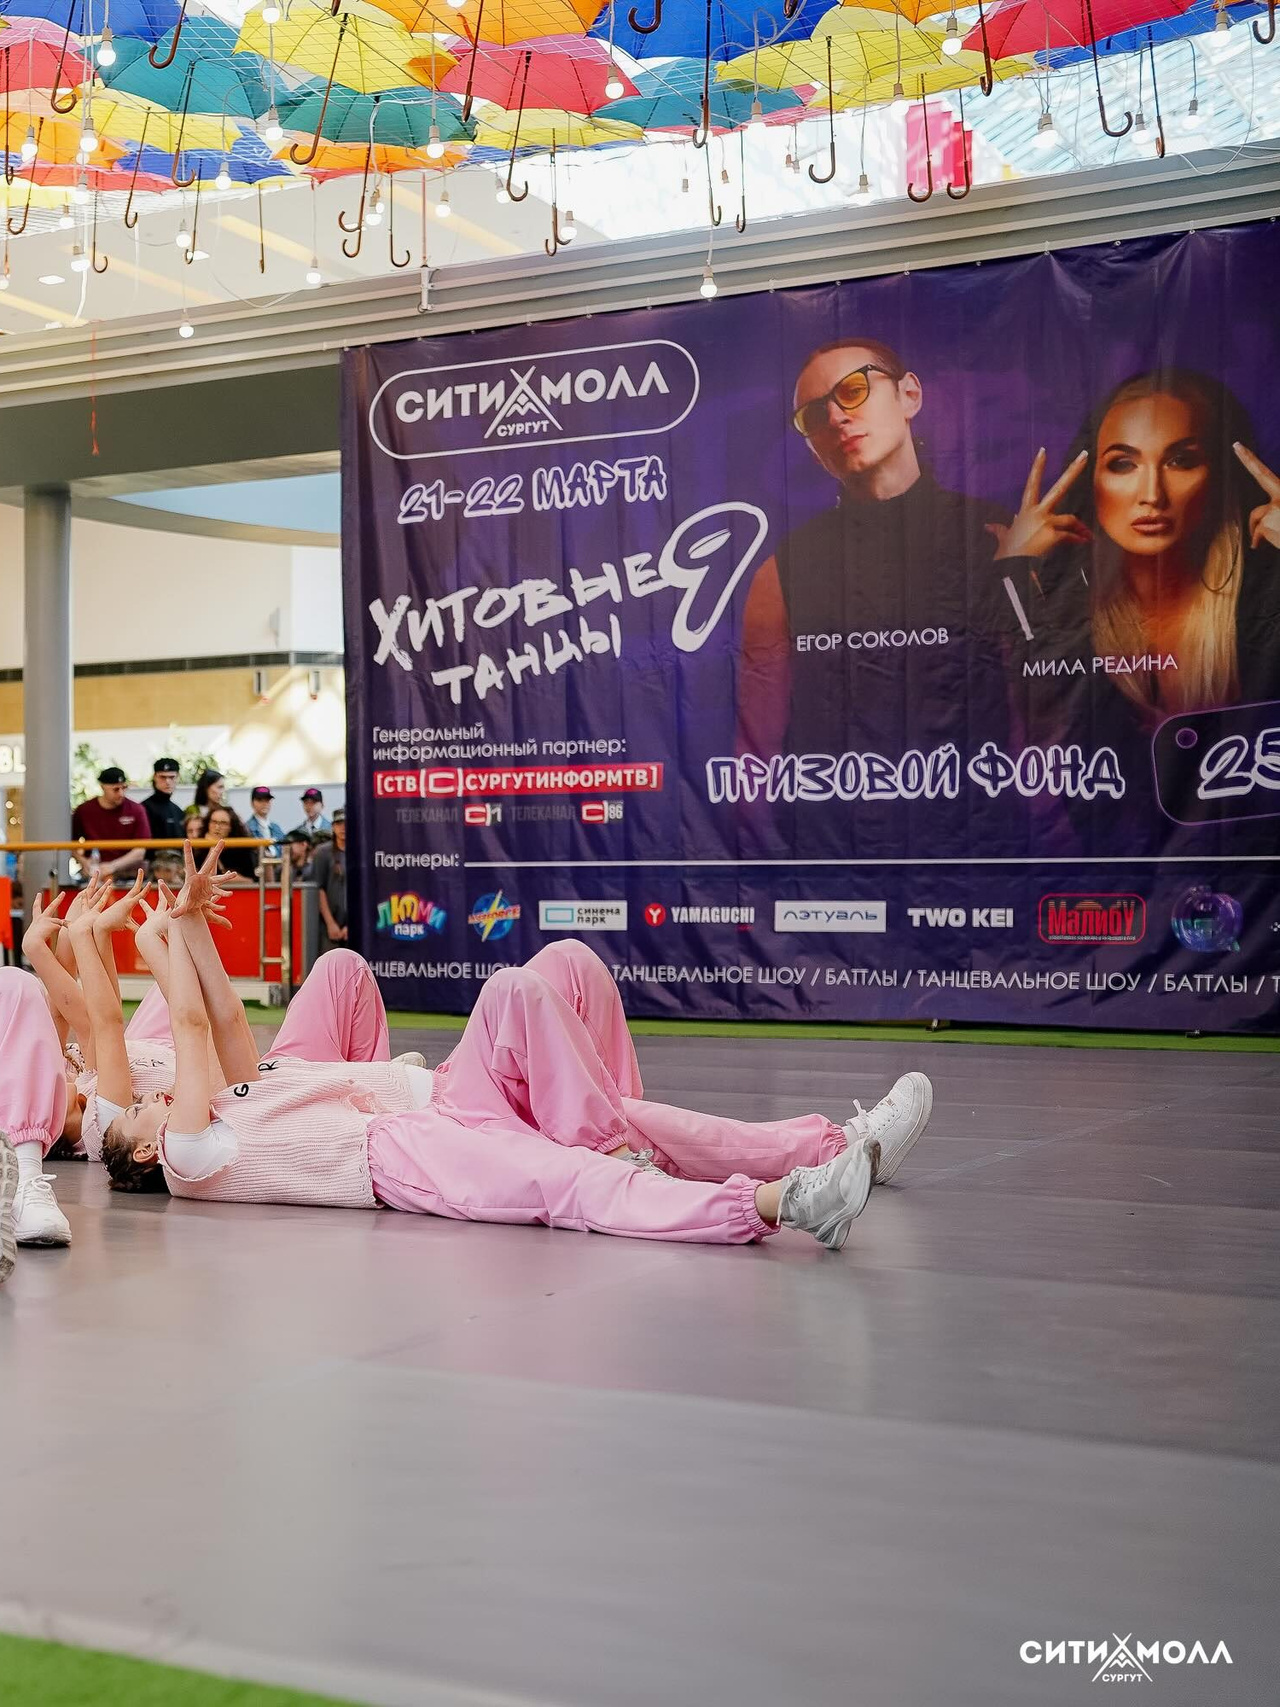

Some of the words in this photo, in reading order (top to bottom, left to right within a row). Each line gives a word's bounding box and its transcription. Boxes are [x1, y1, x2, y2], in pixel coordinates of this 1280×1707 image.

[395, 380, 506, 422] СИТИ
[541, 362, 670, 406] МОЛЛ
[497, 420, 549, 437] СУРГУТ
[397, 475, 524, 524] 21-22
[532, 455, 668, 511] МАРТА
[796, 633, 842, 652] ЕГОР
[847, 627, 949, 650] СОКОЛОВ
[1023, 657, 1086, 678] МИЛА
[1092, 653, 1178, 676] РЕДИНА
[373, 722, 485, 743] Генеральный
[373, 739, 537, 763] информационный
[543, 738, 627, 759] партнер:
[706, 743, 961, 803] ПРИЗОВОЙ
[967, 742, 1126, 800] ФОНД
[375, 850, 460, 871] Партнеры:
[671, 906, 755, 924] YAMAGUCHI
[907, 907, 966, 927] TWO
[972, 907, 1014, 928] KEI
[371, 961, 471, 979] НЦЕВАЛЬНОЕ
[612, 964, 753, 984] ТАНЦЕВАЛЬНОЕ
[758, 966, 807, 984] ШОУ
[825, 968, 897, 987] БАТТЛЫ
[917, 969, 1080, 990] ТАНЦЕВАЛЬНОЕ
[1086, 971, 1141, 992] ШОУ
[1164, 973, 1248, 994] БАТТЛЫ
